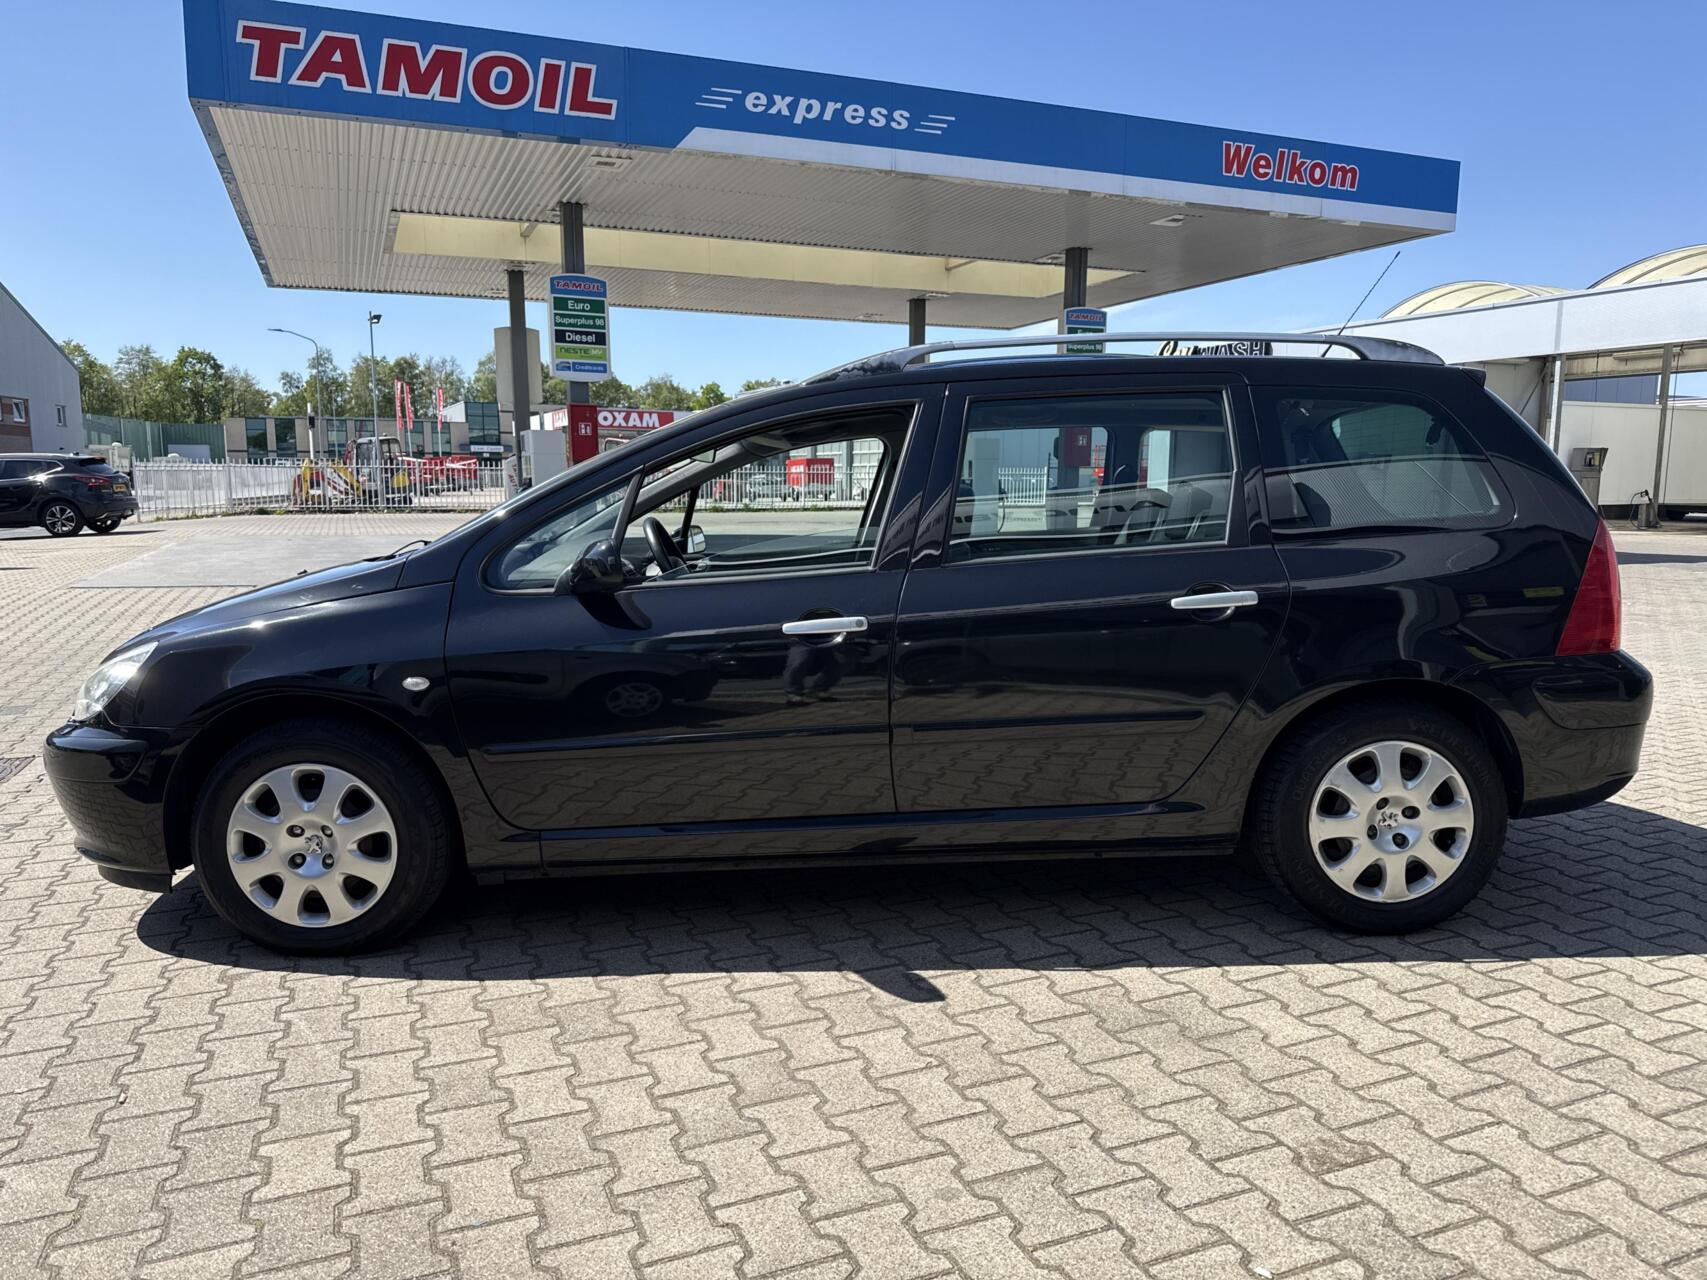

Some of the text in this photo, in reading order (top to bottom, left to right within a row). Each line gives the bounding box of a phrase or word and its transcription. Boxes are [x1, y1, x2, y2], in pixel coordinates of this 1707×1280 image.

[236, 20, 618, 121] TAMOIL
[744, 91, 910, 130] express
[1222, 140, 1360, 192] Welkom
[555, 280, 603, 291] TAMOIL
[567, 300, 591, 311] Euro
[555, 315, 605, 326] Superplus 98
[565, 331, 596, 343] Diesel
[598, 411, 660, 428] OXAM
